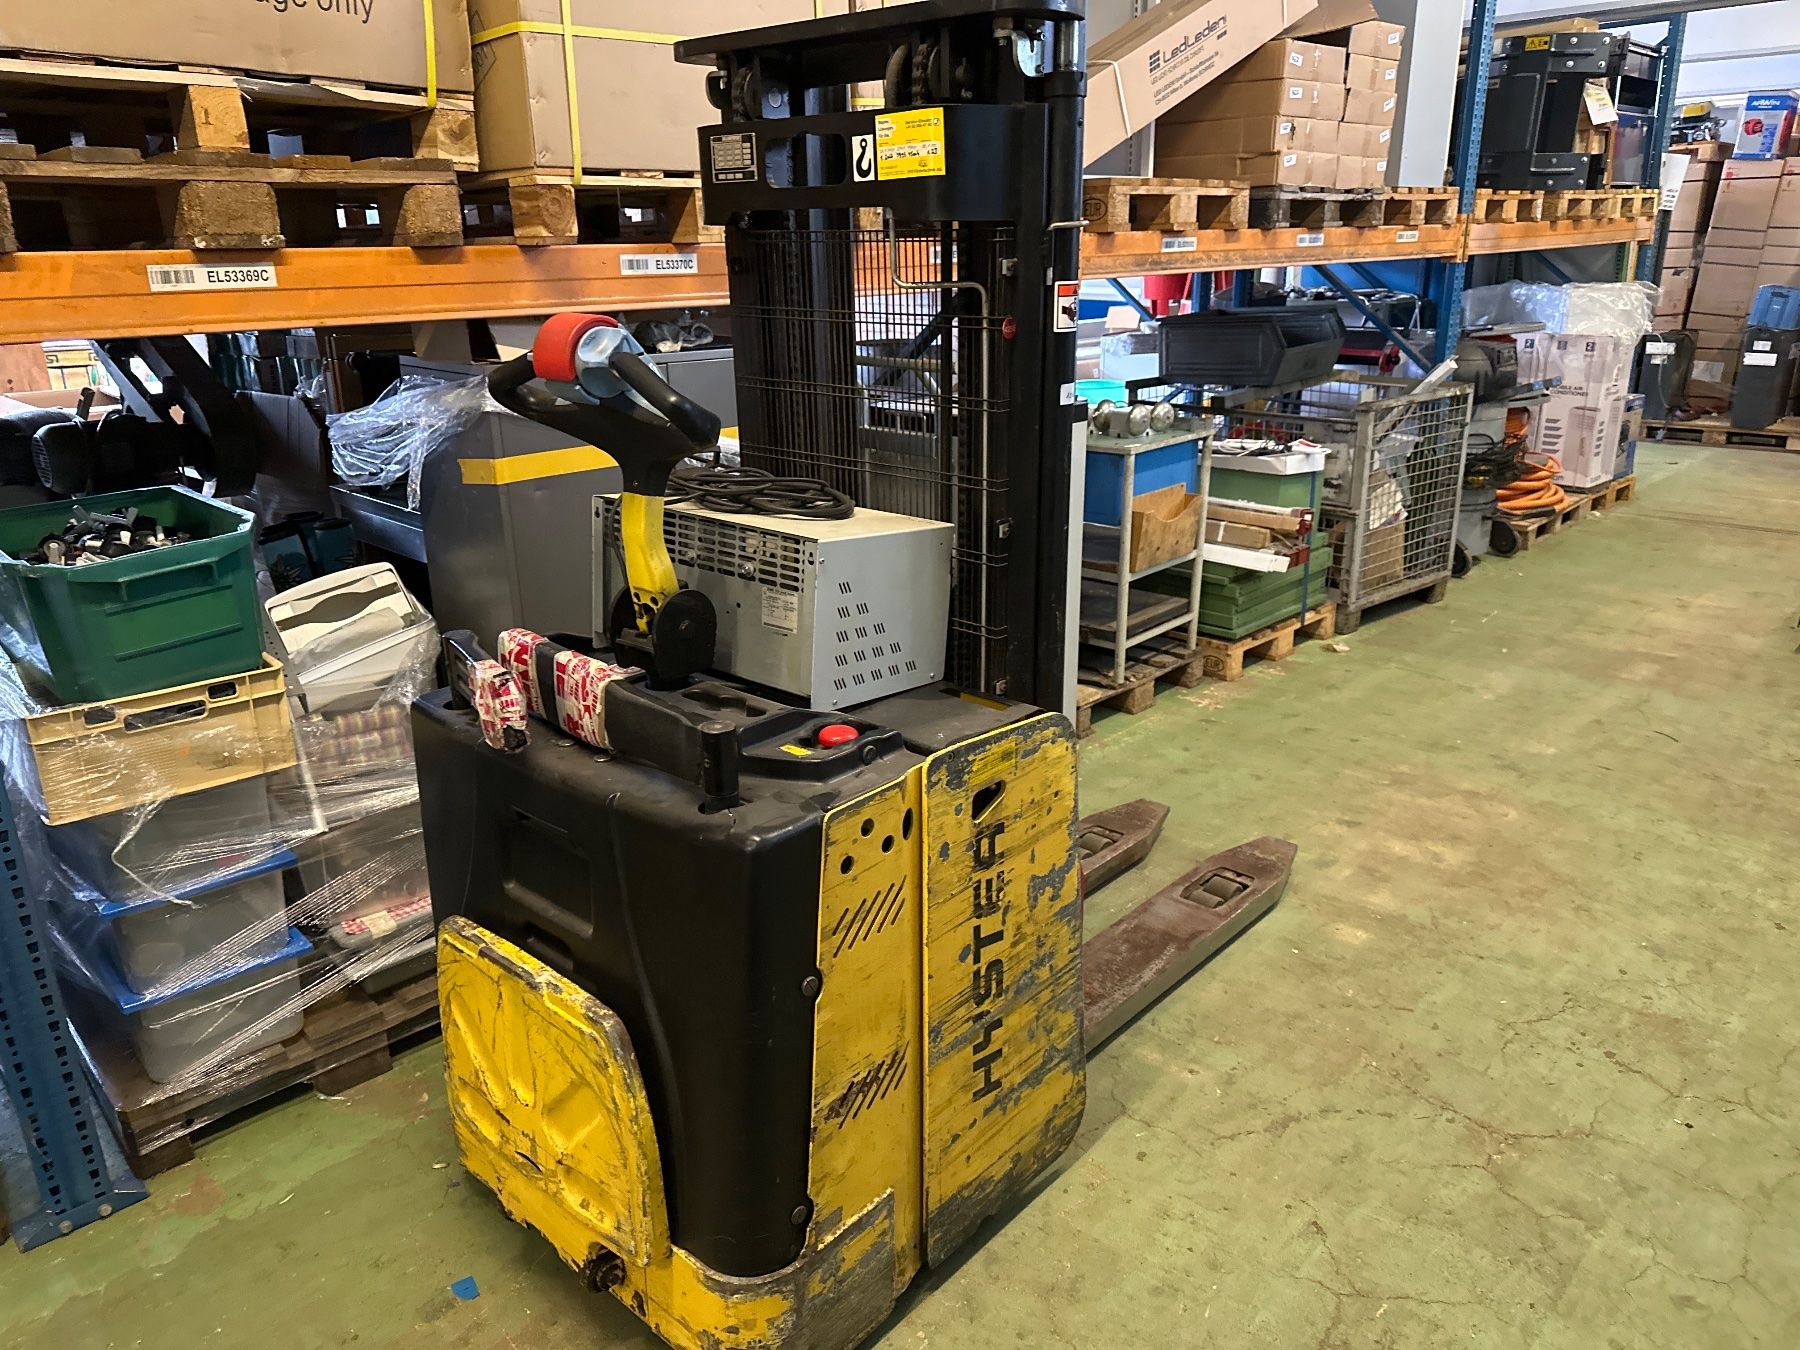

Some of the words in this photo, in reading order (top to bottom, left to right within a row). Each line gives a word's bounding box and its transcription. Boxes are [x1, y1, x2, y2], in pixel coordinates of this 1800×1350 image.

[1162, 14, 1227, 63] LedLeden
[207, 269, 269, 283] EL53369C
[655, 259, 694, 270] EL53370C
[972, 822, 1004, 1102] HYSTER
